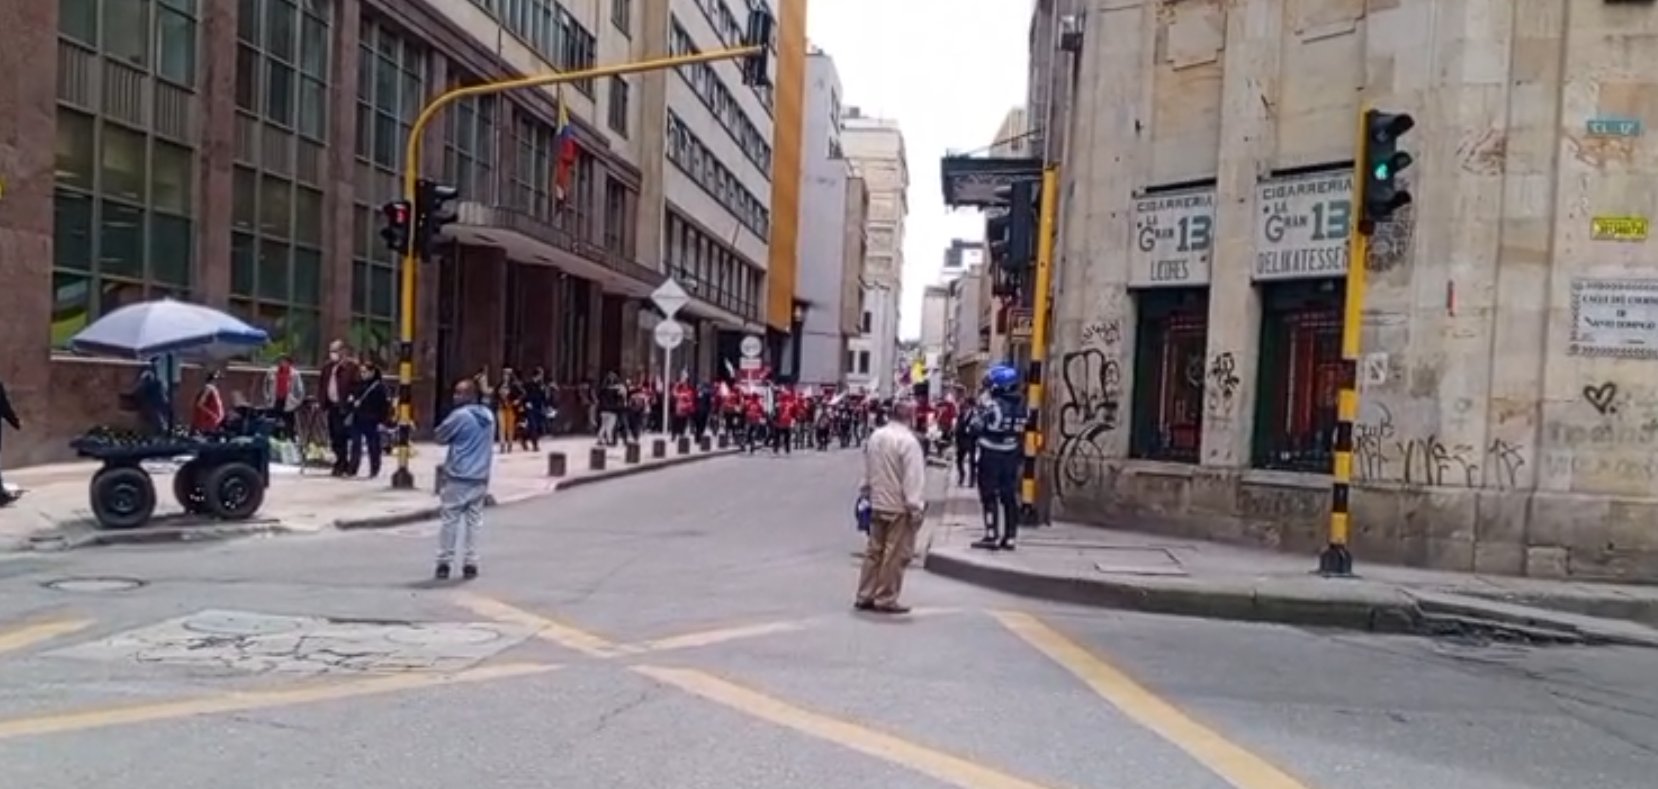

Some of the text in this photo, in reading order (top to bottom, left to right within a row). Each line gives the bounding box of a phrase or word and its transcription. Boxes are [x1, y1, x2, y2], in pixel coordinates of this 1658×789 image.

[1136, 194, 1213, 213] CIGARRERIA
[1262, 177, 1353, 200] CIGARRERIA
[1176, 214, 1213, 252] 13
[1310, 200, 1352, 241] 13
